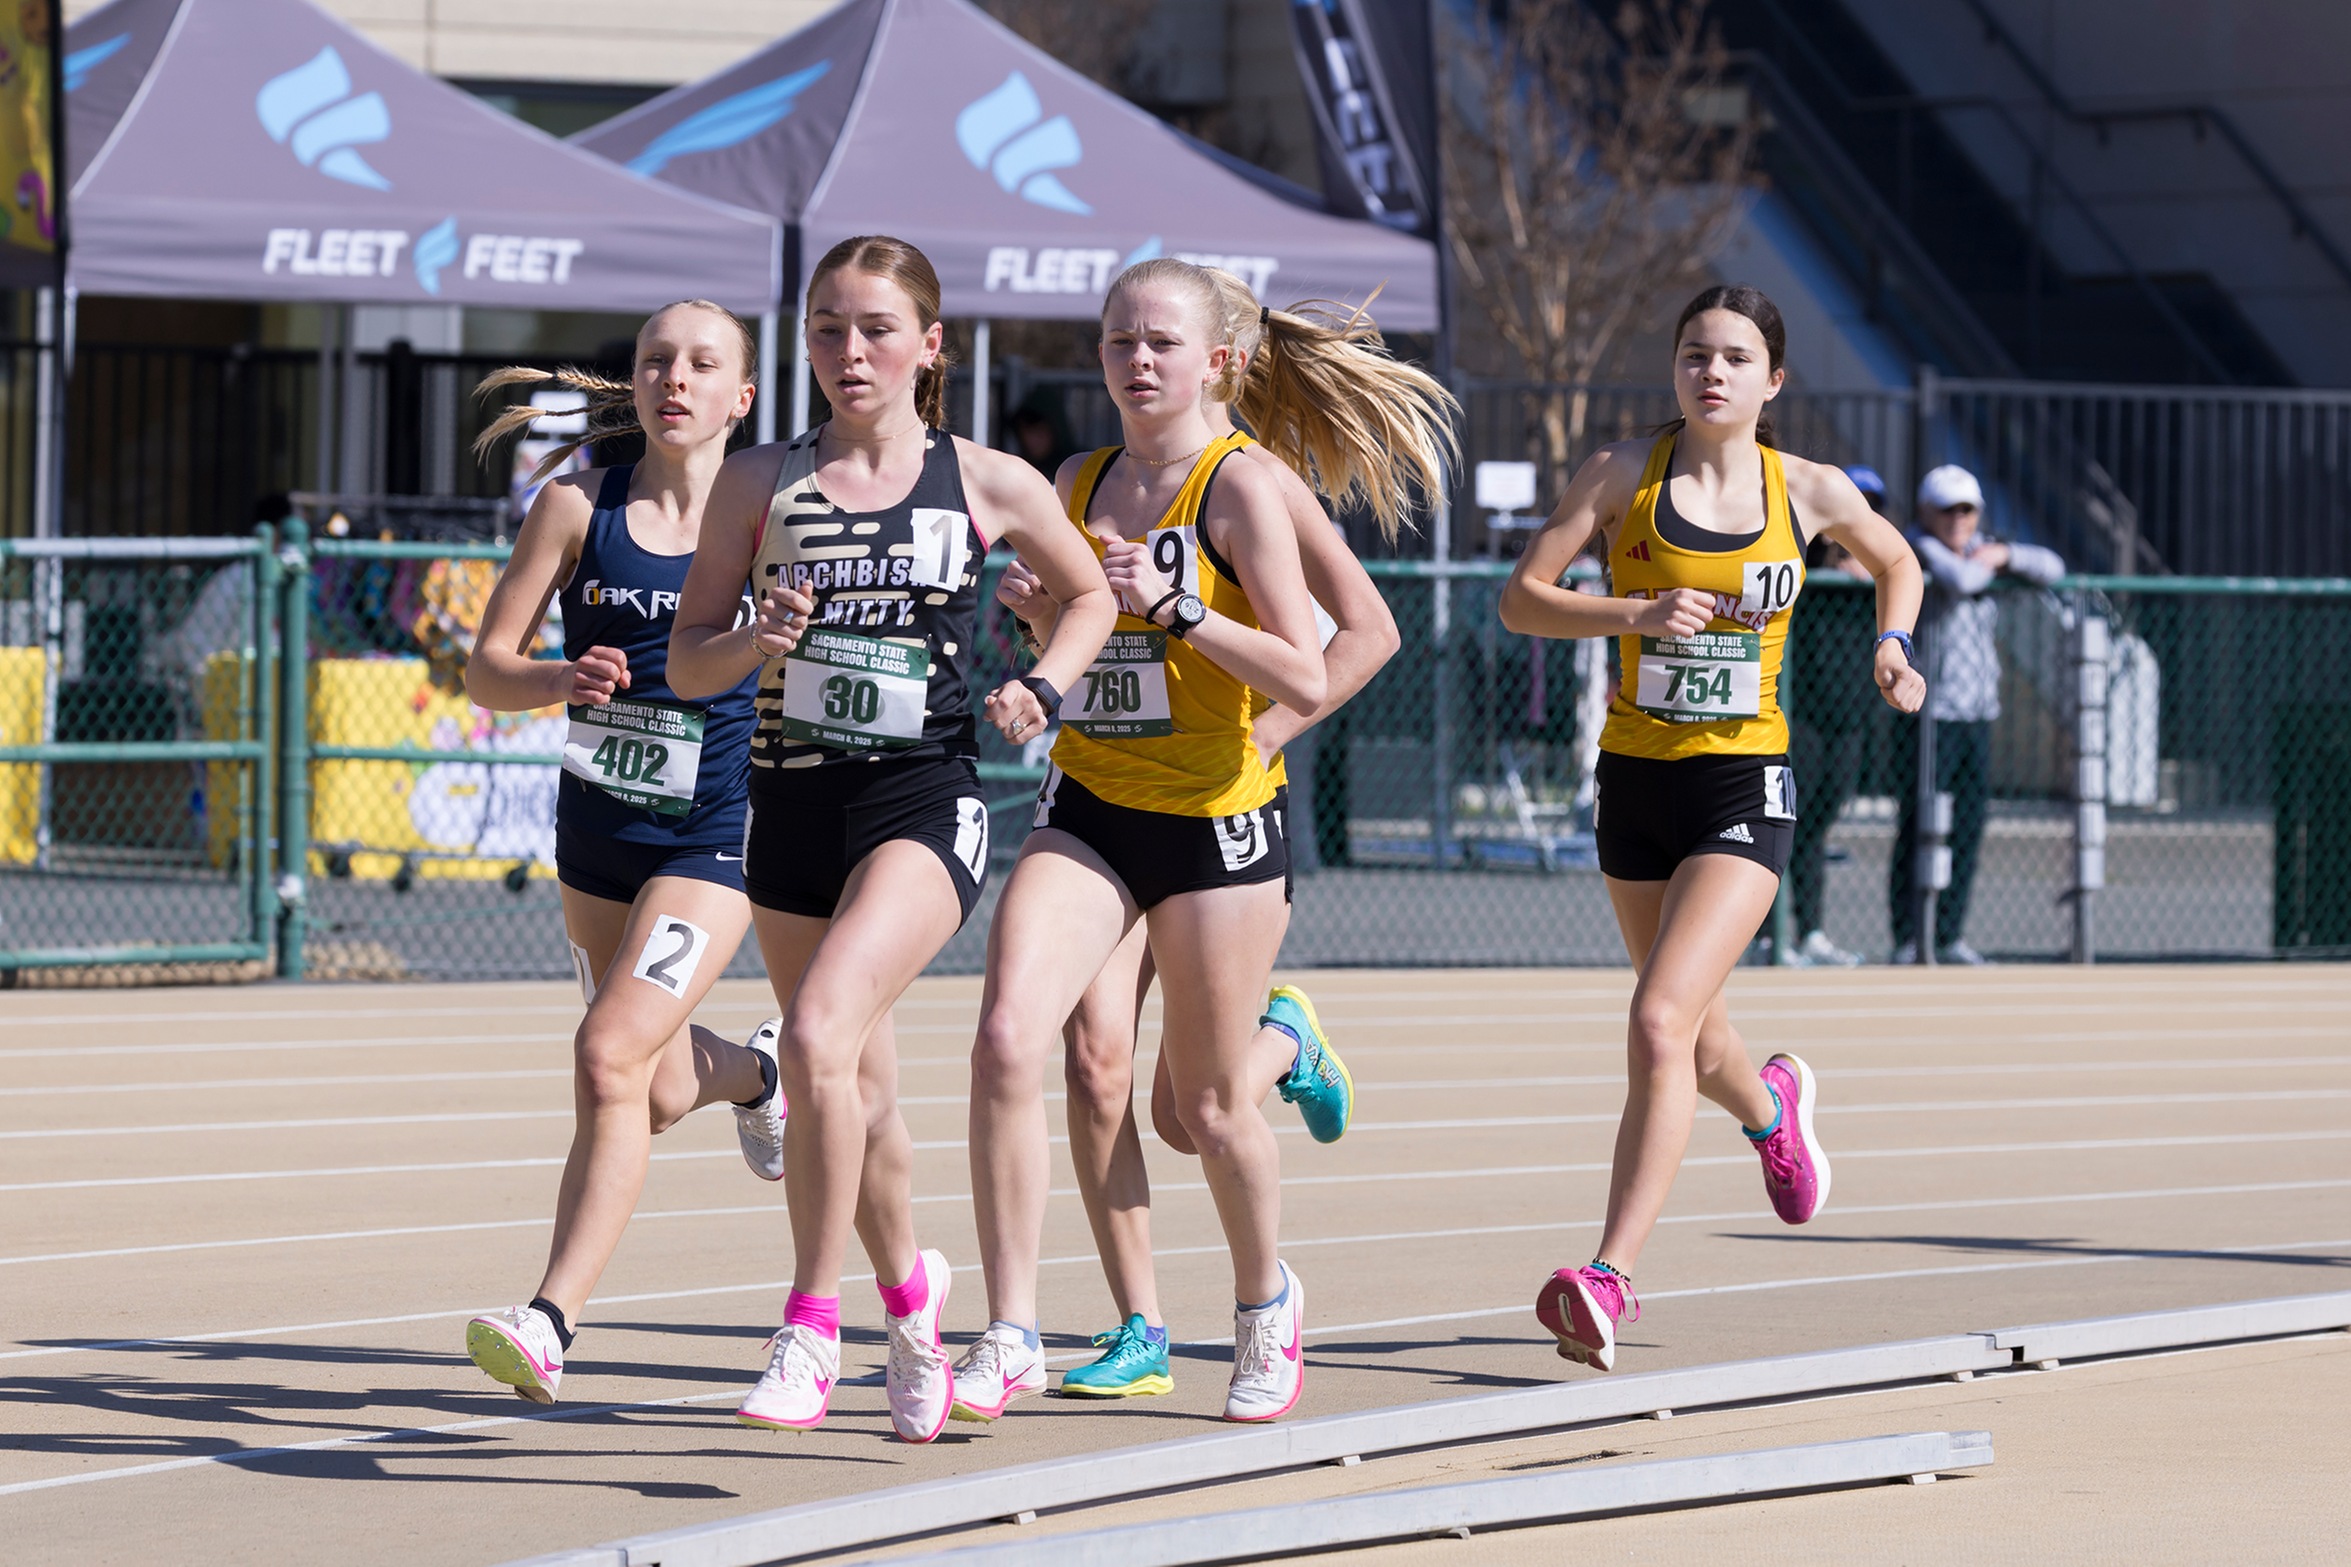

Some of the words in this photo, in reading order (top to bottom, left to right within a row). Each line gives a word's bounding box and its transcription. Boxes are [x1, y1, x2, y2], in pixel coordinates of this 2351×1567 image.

[262, 228, 409, 277] FLEET
[463, 234, 584, 285] FEET
[984, 247, 1119, 294] FLEET
[929, 515, 952, 584] 1
[1154, 531, 1184, 589] 9
[778, 558, 926, 590] ARCHBIS
[1756, 564, 1794, 610] 10
[582, 579, 647, 619] OAK
[820, 600, 915, 626] MITTY
[811, 634, 876, 655] SACRAMENTO
[879, 645, 908, 661] STATE
[1120, 648, 1152, 659] CLASSIC
[1124, 635, 1148, 647] STATE
[1656, 643, 1676, 654] HIGH
[1677, 644, 1709, 657] SCHOOL
[1711, 647, 1746, 659] CLASSIC
[1718, 636, 1742, 647] STATE
[804, 645, 827, 661] HIGH
[829, 649, 867, 667] SCHOOL
[870, 656, 910, 675] CLASSIC
[824, 675, 879, 724] 30
[1082, 671, 1141, 713] 760
[1664, 664, 1732, 705] 754
[587, 709, 609, 723] HIGH
[611, 714, 645, 729] SCHOOL
[648, 720, 686, 737] CLASSIC
[656, 709, 683, 723] STATE
[1094, 724, 1111, 732] MARCH
[823, 731, 845, 742] MARCH
[854, 736, 872, 746] 2025
[592, 735, 669, 787] 402
[630, 795, 647, 804] 2025
[972, 806, 984, 871] 1
[1224, 813, 1256, 864] 9
[1719, 831, 1754, 844] adidas
[646, 923, 694, 990] 2
